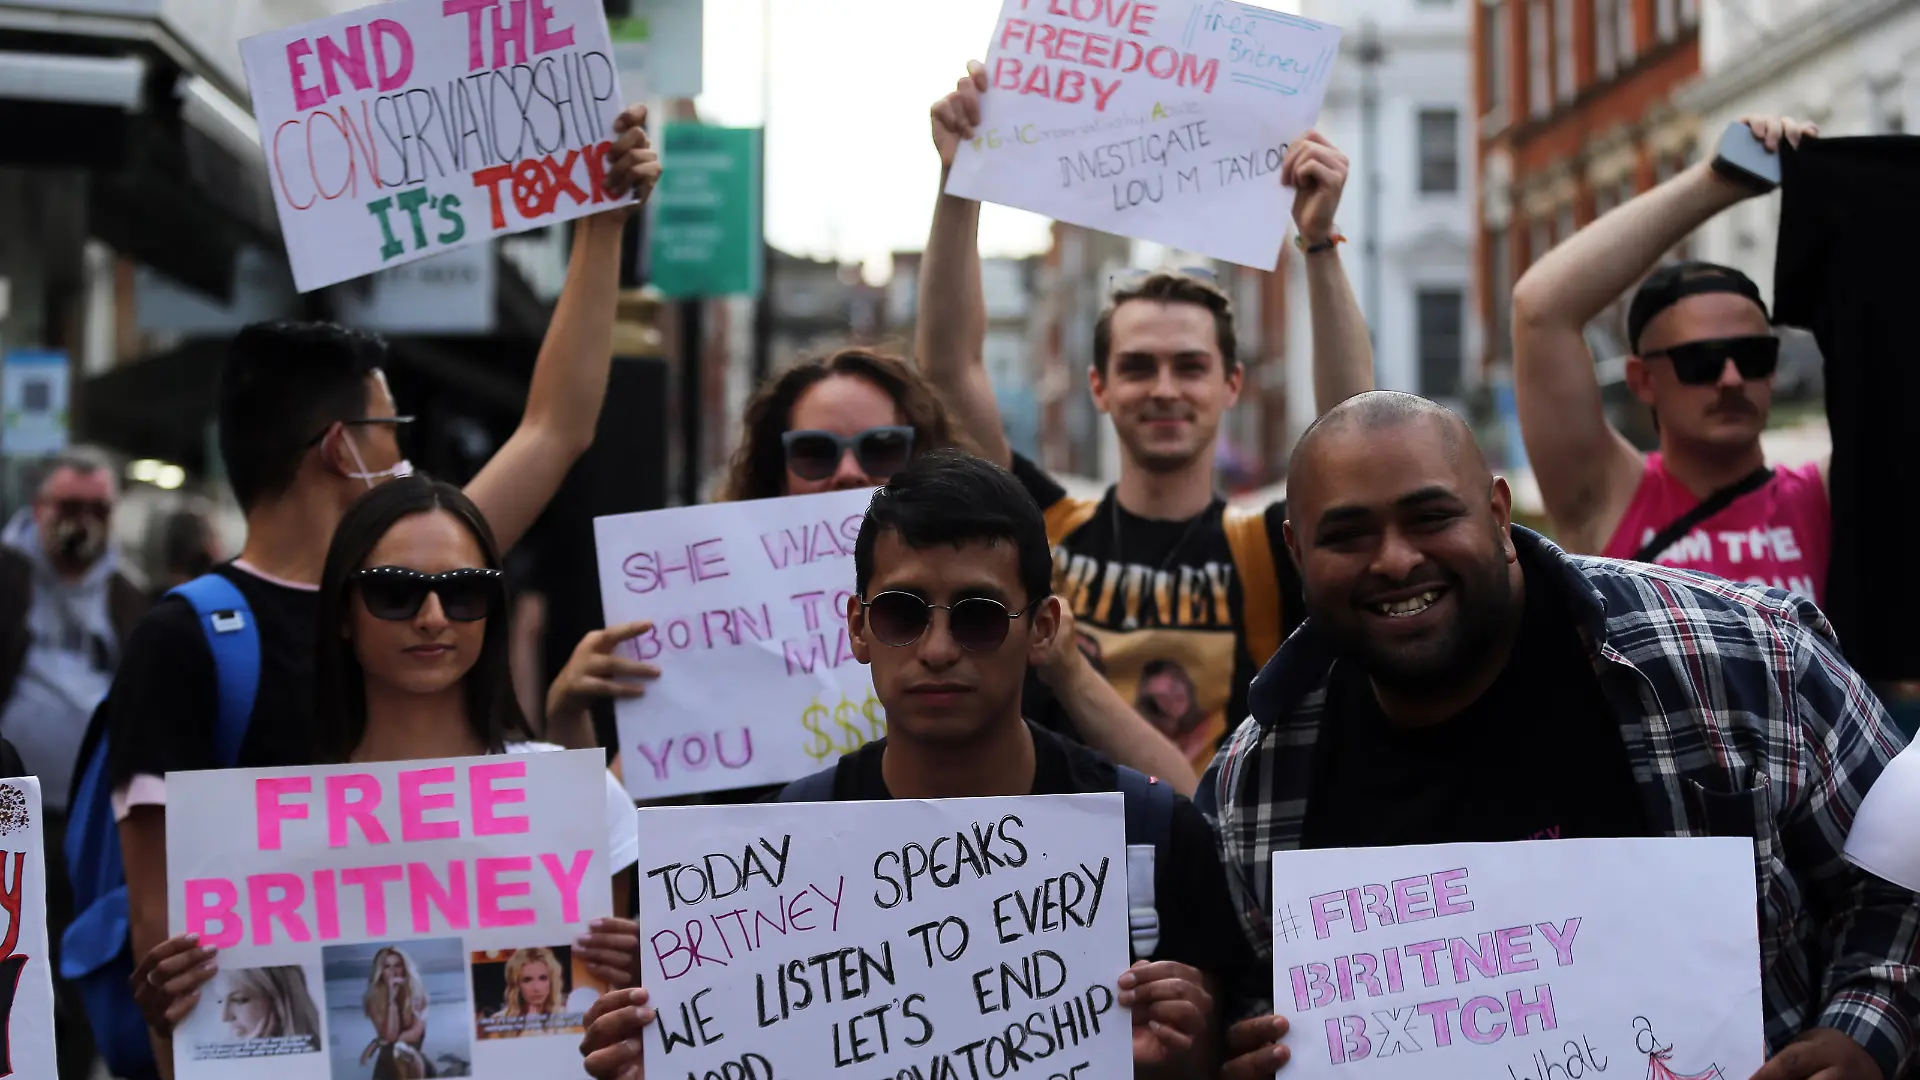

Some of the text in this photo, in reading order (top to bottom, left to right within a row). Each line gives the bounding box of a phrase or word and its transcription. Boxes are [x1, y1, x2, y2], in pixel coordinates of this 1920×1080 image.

[286, 0, 575, 112] END THE
[993, 56, 1122, 112] BABY
[1000, 18, 1219, 94] FREEDOM
[1229, 37, 1309, 82] Britney
[274, 51, 615, 210] CONSERVATORSHIP
[1059, 120, 1212, 189] INVESTIGATE
[367, 186, 466, 261] IT'S
[1113, 177, 1163, 211] LOU
[1177, 165, 1201, 194] M
[622, 514, 864, 594] SHE WAS
[1718, 525, 1802, 563] THE
[632, 603, 772, 661] BORN
[636, 727, 755, 781] YOU
[255, 761, 530, 850] FREE
[184, 849, 594, 950] BRITNEY
[647, 834, 791, 911] TODAY
[650, 875, 844, 980] BRITNEY
[655, 857, 1110, 1054] WE LISTEN TO EVERY
[1289, 917, 1583, 1013] BRITNEY
[832, 949, 1067, 1068] LET'S END
[1632, 1016, 1661, 1054] a
